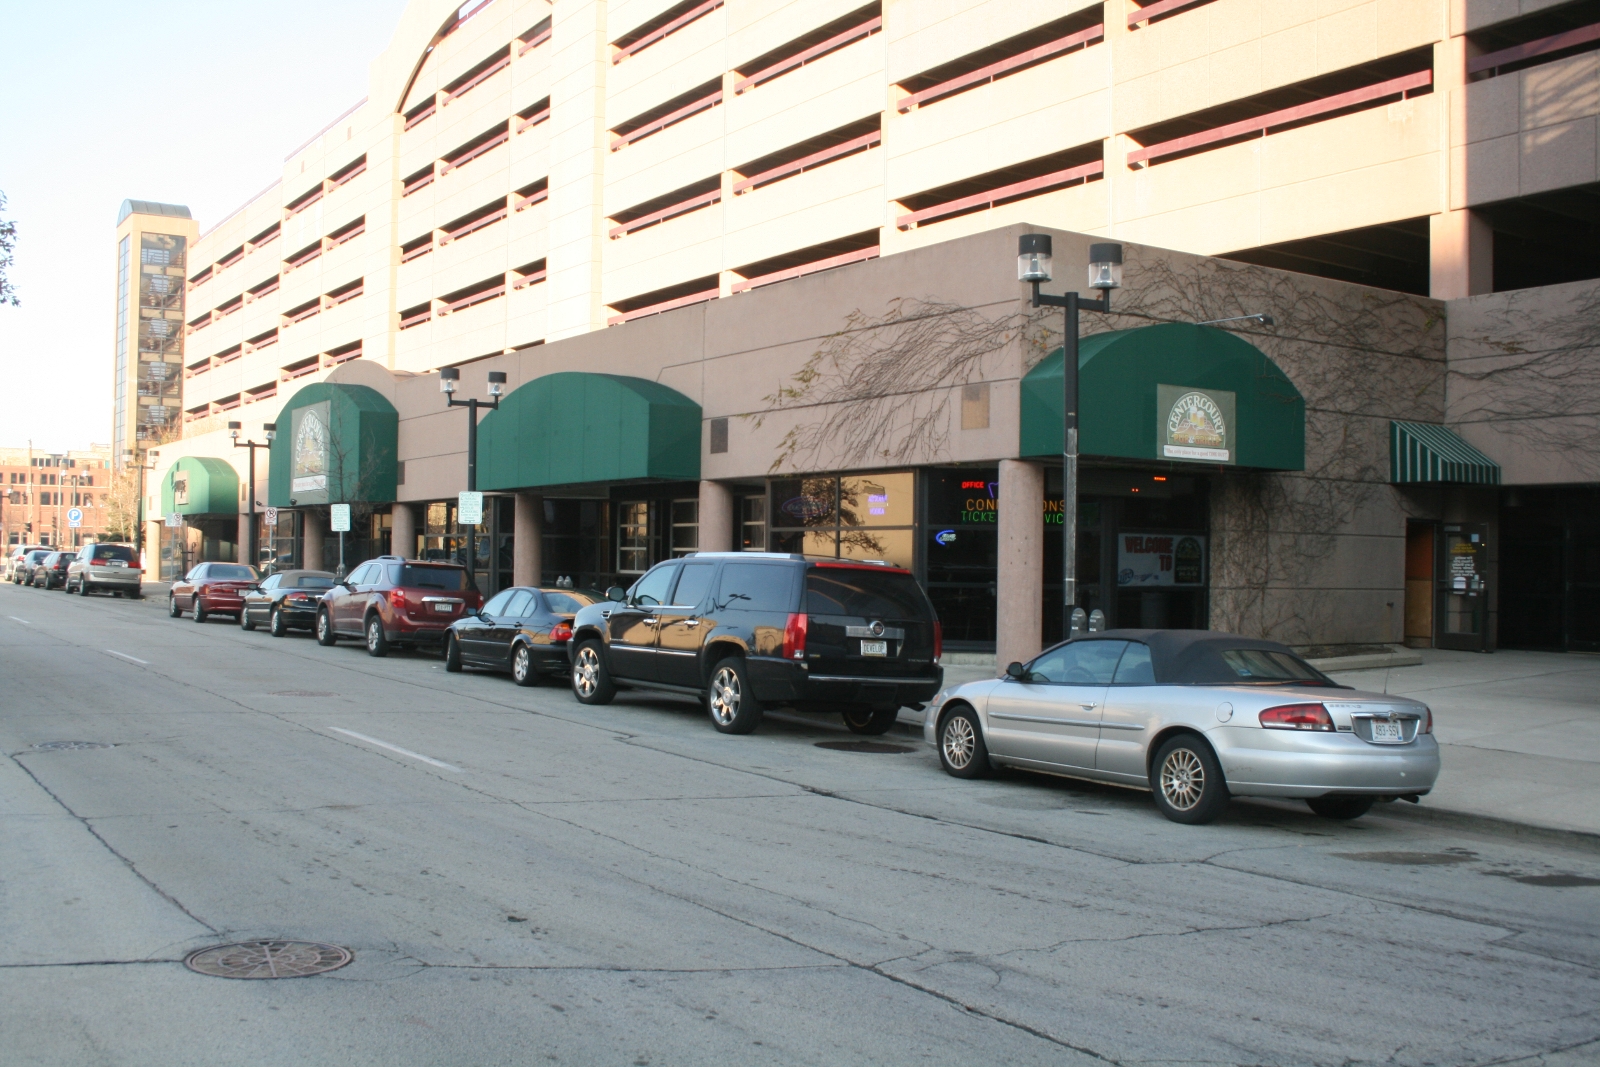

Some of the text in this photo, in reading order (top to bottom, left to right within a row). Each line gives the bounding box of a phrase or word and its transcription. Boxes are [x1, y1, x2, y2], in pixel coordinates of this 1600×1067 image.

[1173, 434, 1188, 443] PUB
[1188, 435, 1195, 443] &
[961, 481, 984, 489] OFFICE
[961, 510, 998, 522] TICKE
[1125, 536, 1174, 554] WELCOME
[1159, 555, 1173, 571] TO
[863, 644, 885, 652] DEVELOP
